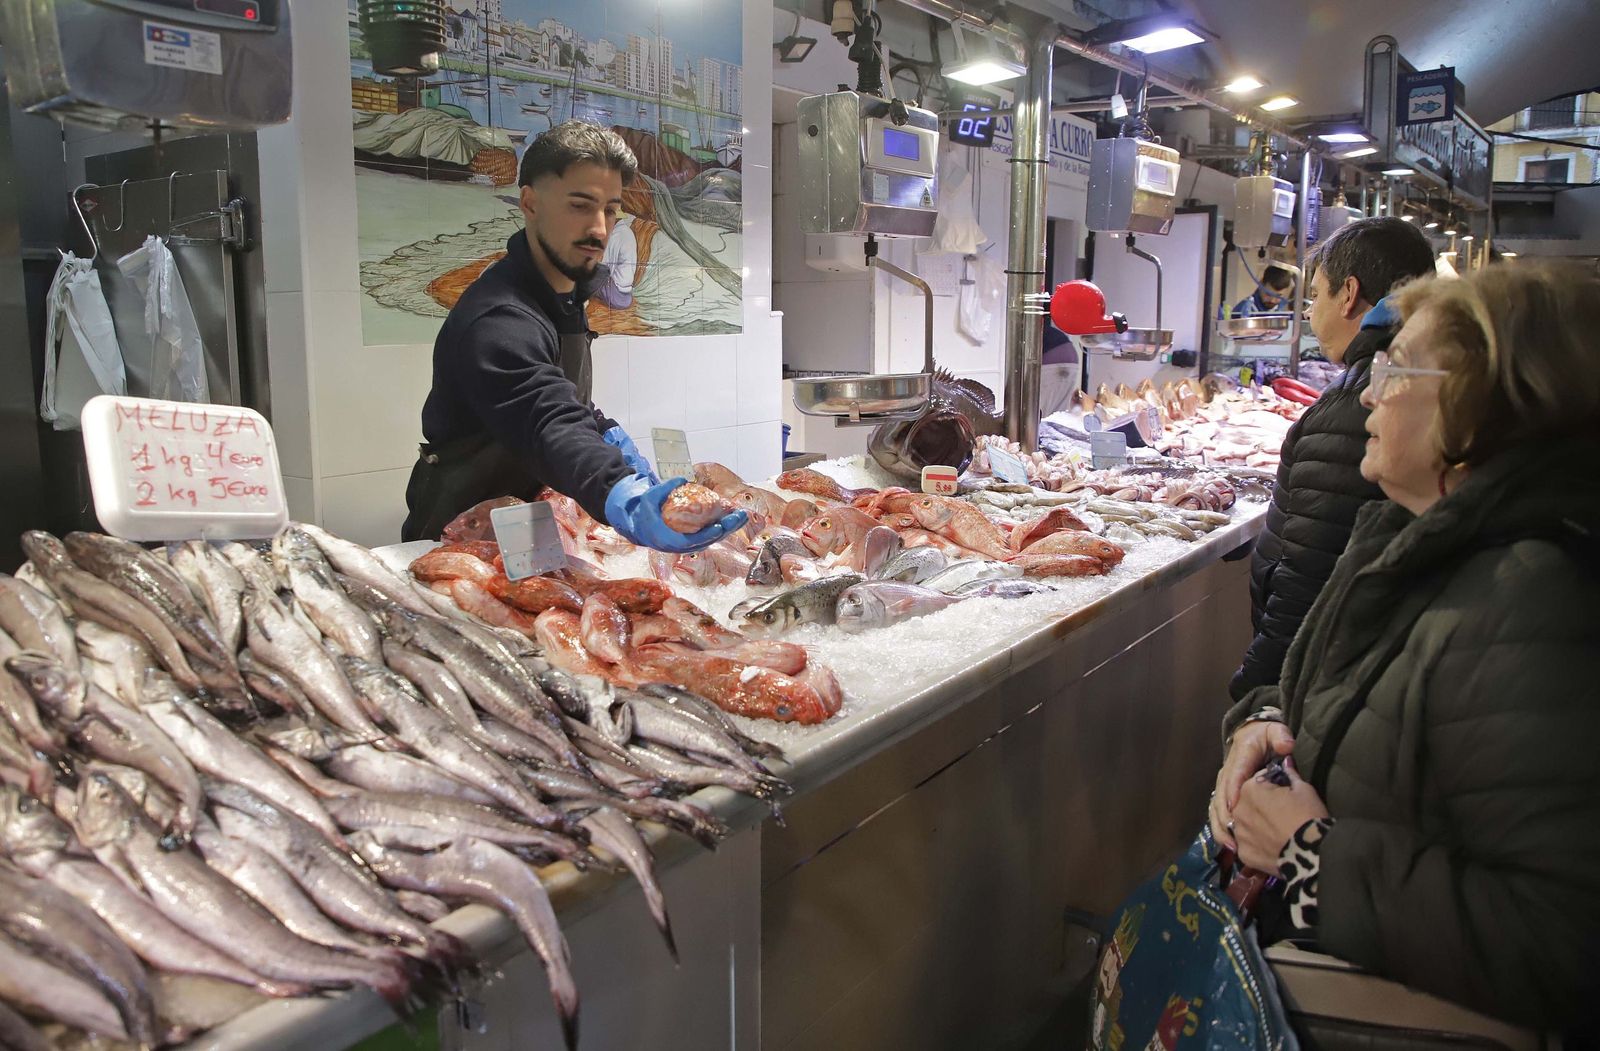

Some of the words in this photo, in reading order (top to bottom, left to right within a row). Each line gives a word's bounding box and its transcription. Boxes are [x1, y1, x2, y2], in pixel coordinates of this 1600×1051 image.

[115, 402, 260, 438] MELUZA
[130, 443, 156, 472] 1
[161, 446, 193, 477] kg
[207, 441, 225, 468] 4
[136, 481, 157, 506] 2
[168, 483, 197, 507] kg
